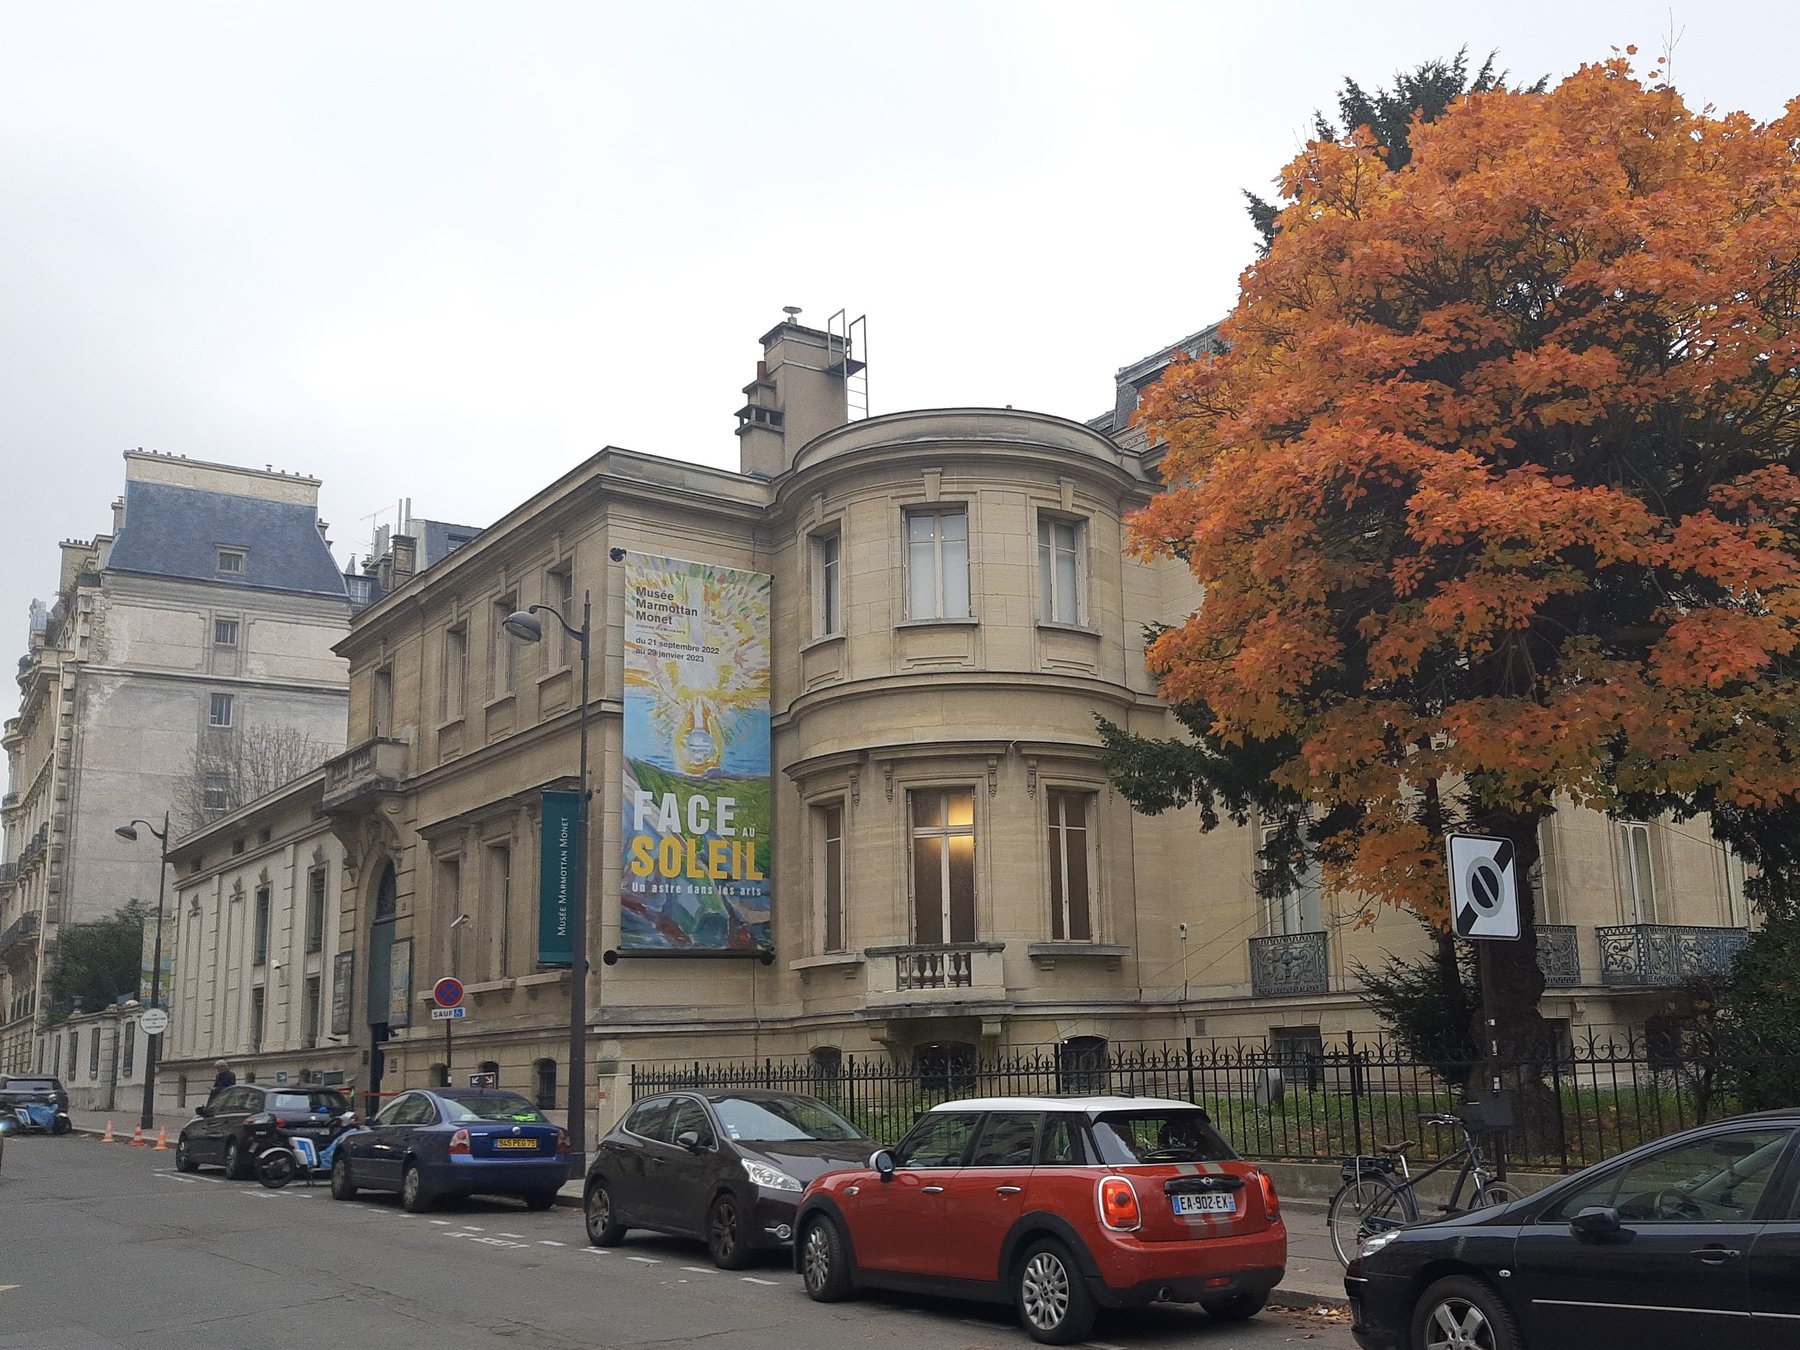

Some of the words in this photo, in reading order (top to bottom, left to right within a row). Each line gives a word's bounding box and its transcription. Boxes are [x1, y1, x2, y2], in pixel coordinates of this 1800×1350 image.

[636, 586, 674, 601] Musée
[636, 599, 698, 617] Marmottan
[636, 610, 673, 625] Monet
[635, 637, 646, 646] du
[647, 639, 657, 647] 21
[658, 640, 700, 653] septembre
[702, 646, 720, 655] 2022
[635, 648, 646, 656] au
[647, 649, 657, 657] 29
[658, 650, 685, 660] janvier
[686, 654, 705, 663] 2023
[633, 790, 736, 837] FACE
[742, 827, 756, 838] AU
[631, 835, 764, 881] SOLEIL
[632, 882, 646, 893] Un
[651, 883, 682, 894] astre
[687, 884, 713, 895] dans
[718, 885, 735, 896] les
[740, 886, 762, 896] arts
[433, 1010, 453, 1018] SAUF
[1180, 1195, 1229, 1210] EA-902-EX
